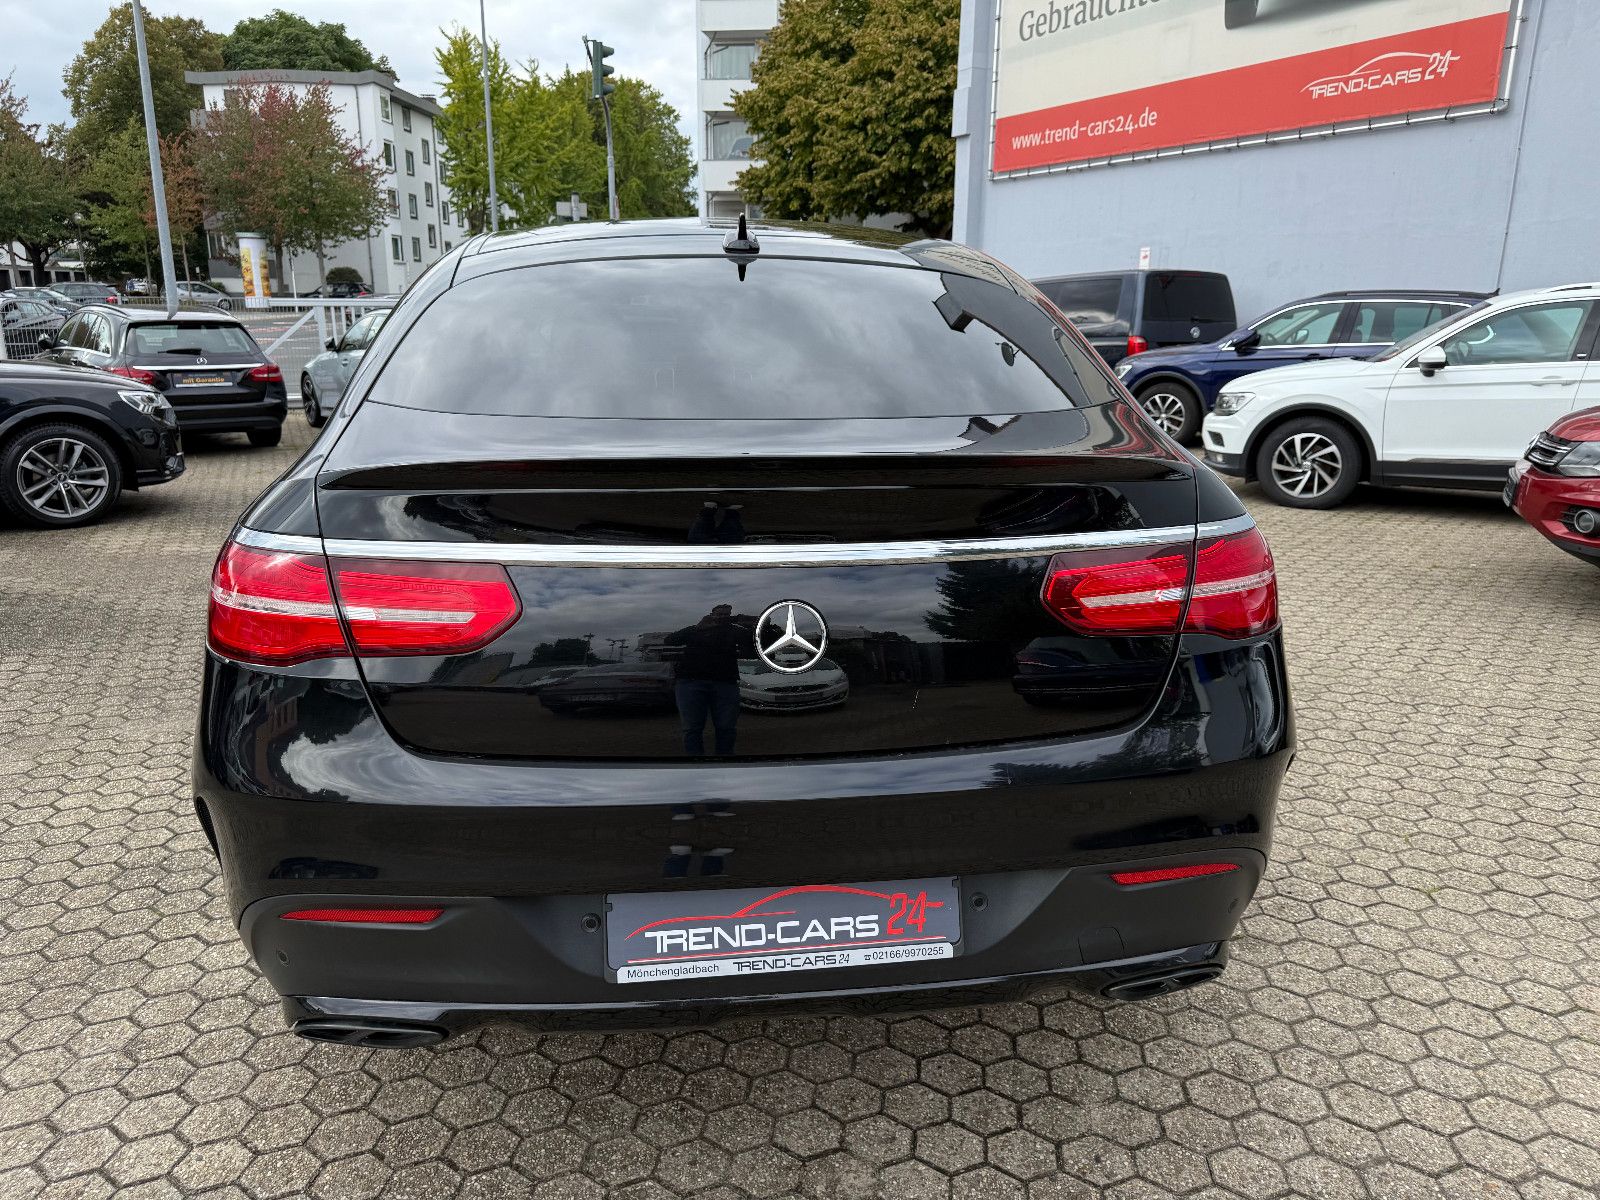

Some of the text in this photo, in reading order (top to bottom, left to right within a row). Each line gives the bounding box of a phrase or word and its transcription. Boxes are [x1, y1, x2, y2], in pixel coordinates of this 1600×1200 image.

[1309, 50, 1459, 99] TREND-CARS 24
[1011, 107, 1158, 150] www.trend-cars24.de
[645, 890, 943, 954] TREND-CARS 24
[626, 946, 944, 979] Mönchengladbach TREND-CARS 24 02166/9970255
